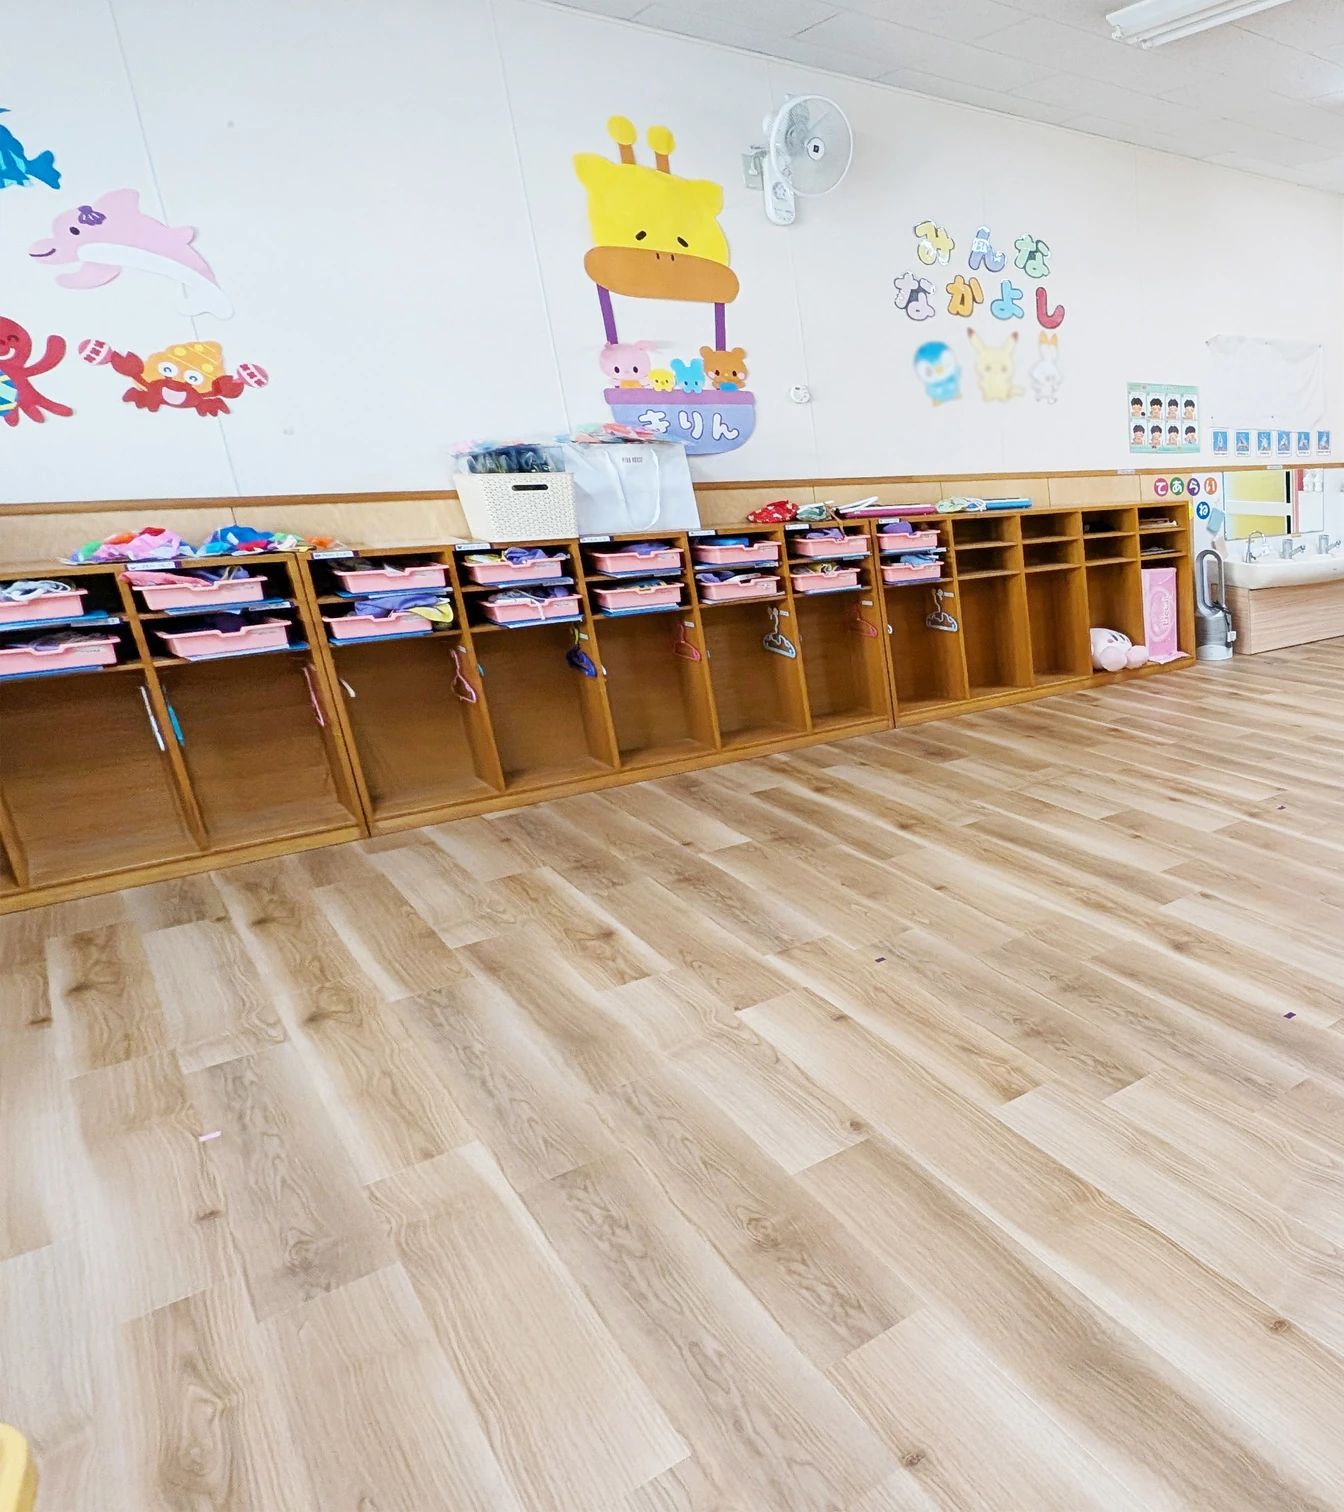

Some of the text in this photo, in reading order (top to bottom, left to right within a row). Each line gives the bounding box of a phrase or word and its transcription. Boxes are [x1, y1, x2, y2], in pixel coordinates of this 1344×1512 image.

[913, 219, 1051, 279] みんな
[893, 272, 1066, 330] なかよし
[637, 409, 740, 441] きりん
[1155, 478, 1216, 495] てあらい
[1197, 503, 1209, 517] ね
